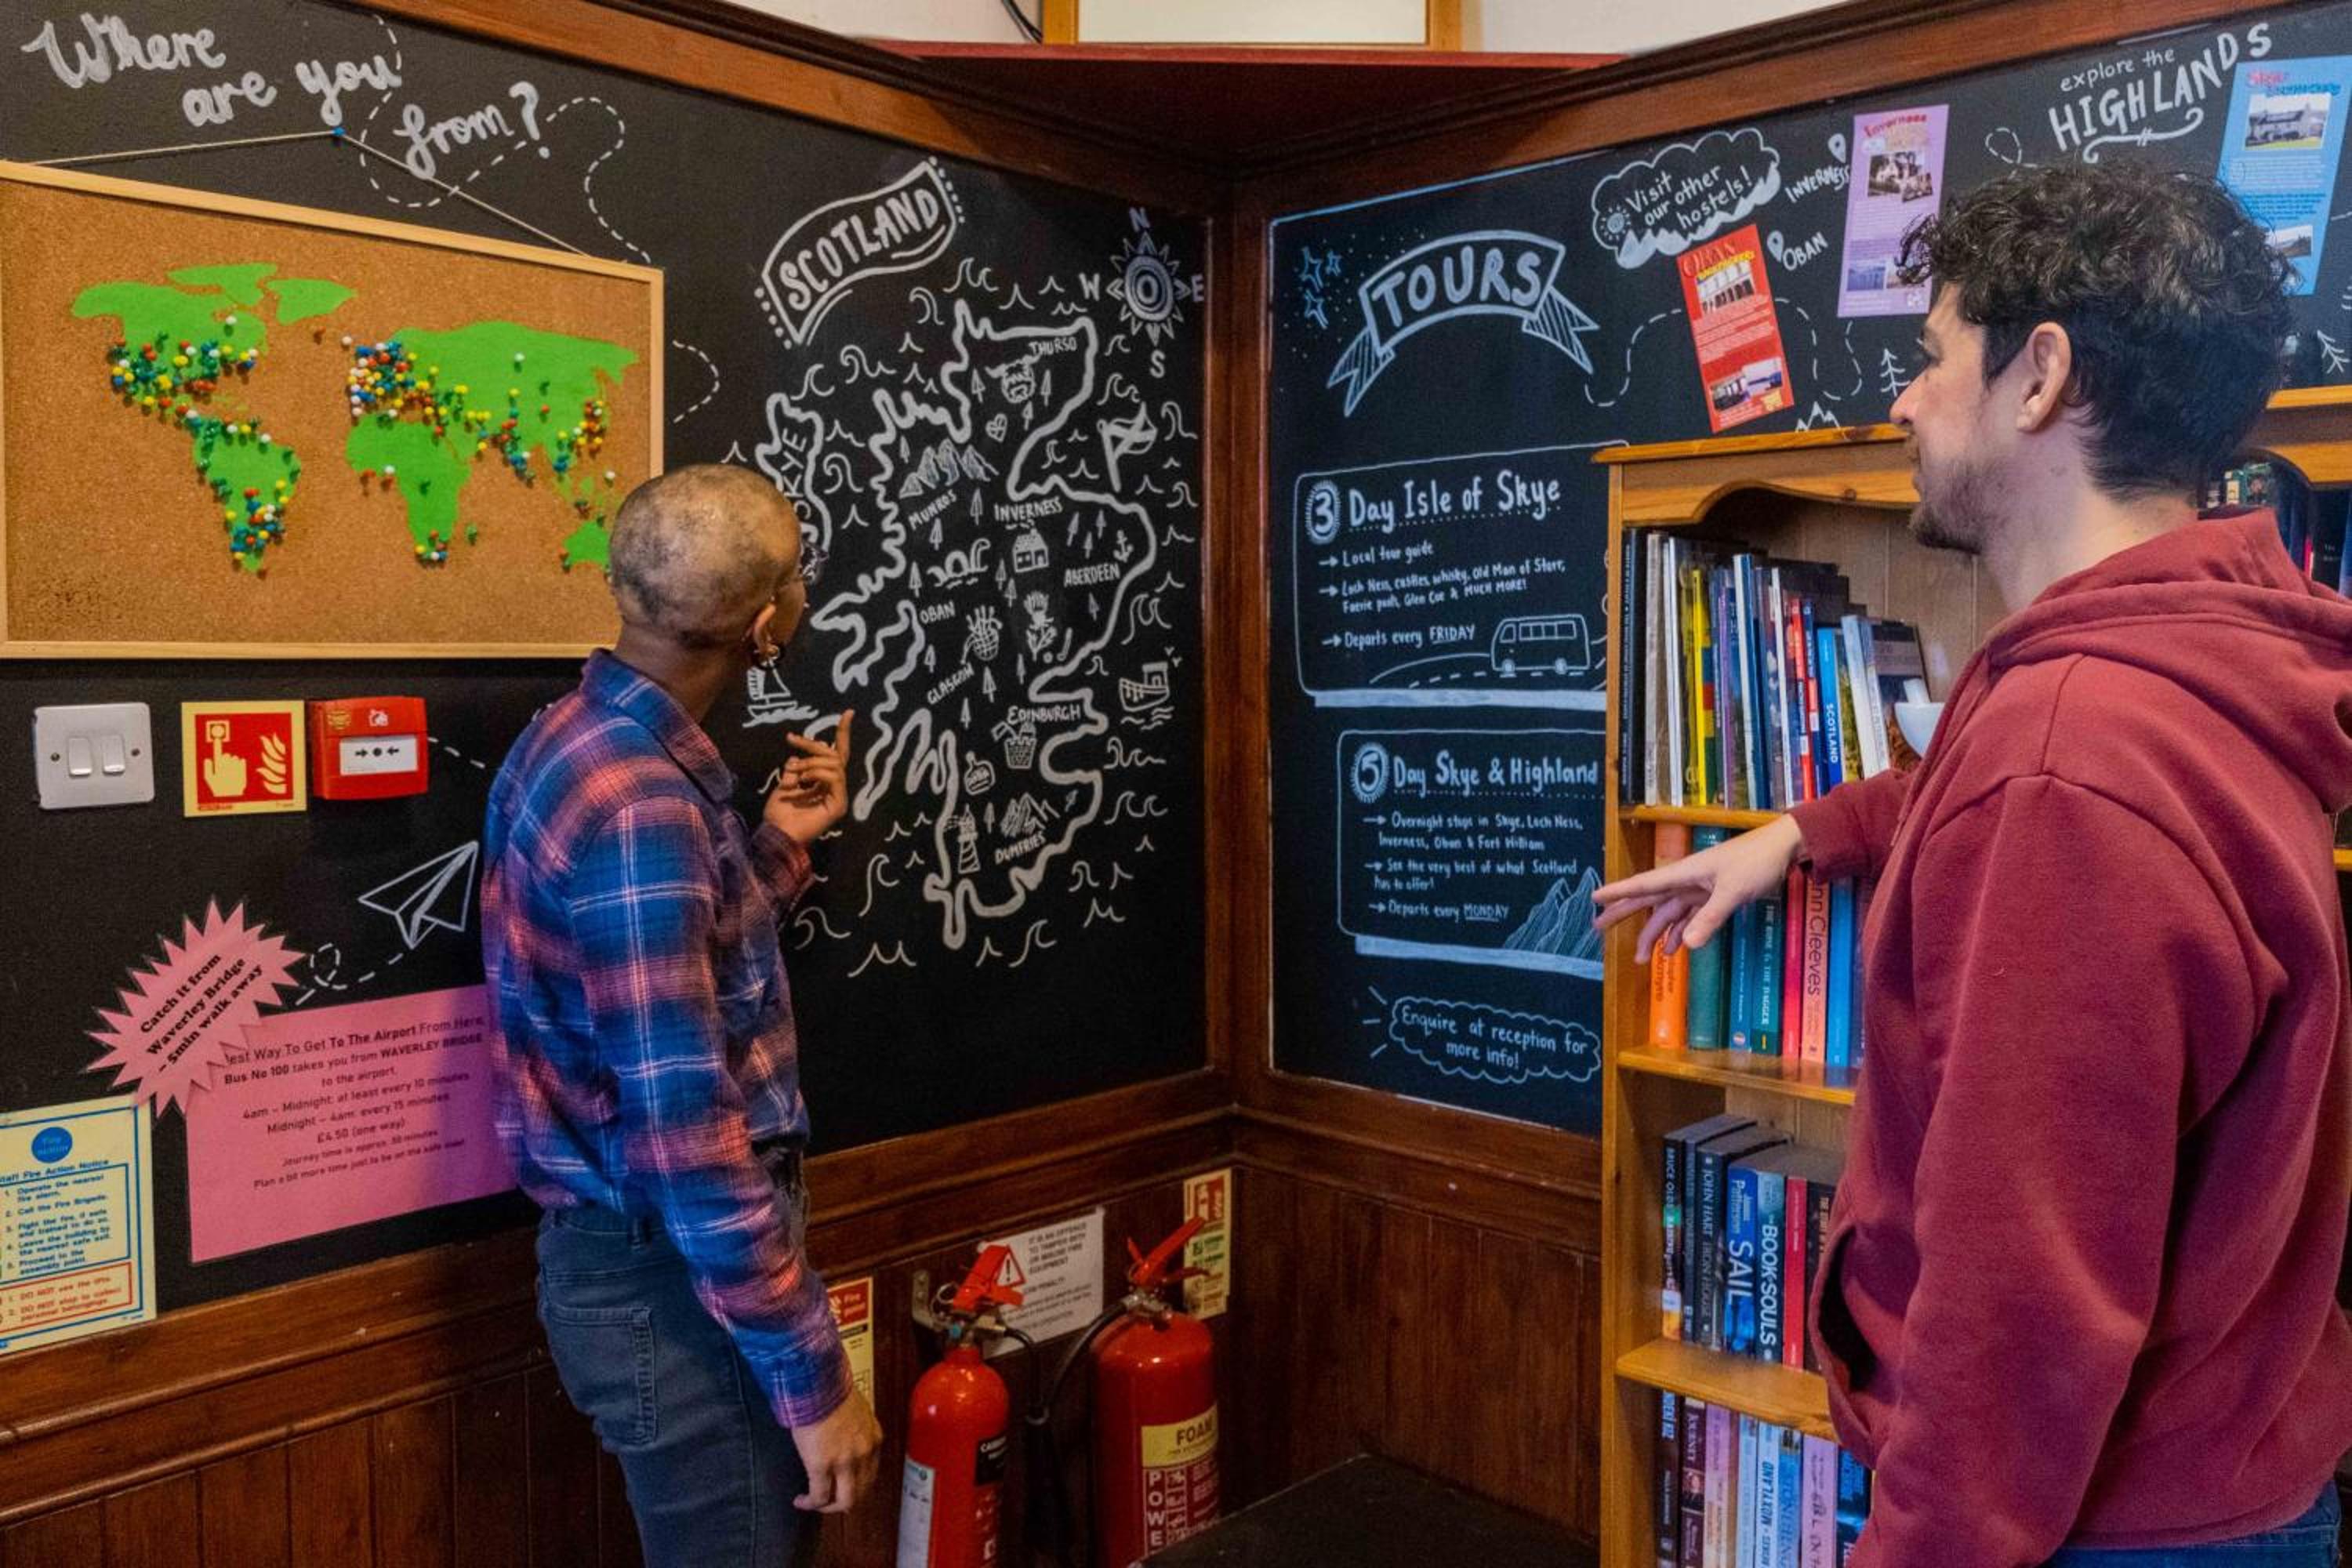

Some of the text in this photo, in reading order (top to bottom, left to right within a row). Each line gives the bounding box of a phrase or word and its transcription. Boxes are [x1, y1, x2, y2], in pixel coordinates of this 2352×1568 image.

[21, 13, 226, 89] Where
[2060, 49, 2175, 92] explore the
[183, 56, 401, 127] are you
[2048, 23, 2272, 152] HIGHLANDS
[1625, 170, 1672, 212] Visit
[1645, 165, 1721, 226] our other
[1677, 165, 1752, 229] hostels!
[1785, 163, 1850, 203] INVERNESS
[1129, 207, 1150, 231] N
[779, 188, 939, 310] SCOTLAND
[1782, 232, 1828, 270] OBAN
[1079, 273, 1100, 301] W
[1192, 274, 1204, 302] E
[1372, 245, 1541, 327] TOURS
[1029, 337, 1077, 354] THURSO
[1149, 350, 1165, 378] S
[909, 489, 956, 530] MUNROS
[994, 496, 1063, 521] INVERNESS
[1314, 470, 1561, 533] 3 Day Isle of Skye
[1342, 539, 1434, 567] Local tour guide
[1064, 563, 1120, 587] ABERDEEN
[1342, 580, 1363, 597] Loch
[1472, 565, 1490, 579] Old
[1492, 562, 1515, 577] Man
[1519, 559, 1530, 575] of
[920, 601, 956, 624] OBAN
[1342, 599, 1373, 614] Faerie
[1403, 592, 1426, 607] Glen
[1428, 590, 1445, 605] Coe
[1465, 581, 1491, 597] MUCH
[1496, 577, 1527, 593] MORE!
[1345, 624, 1475, 650] Departs every FRIDAY
[927, 663, 975, 704] GLASGOW
[1007, 705, 1080, 724] EDINBURGH
[1826, 702, 1838, 764] SCOTLAND
[1360, 750, 1598, 797] 5 Day Skye & Highland
[1379, 832, 1430, 850] Inverness,
[1434, 836, 1463, 849] Oban
[1478, 834, 1500, 850] Fort
[1505, 836, 1545, 851] William
[1392, 811, 1443, 832] Overnight
[1446, 814, 1473, 829] stops
[1478, 814, 1489, 827] in
[1527, 815, 1552, 829] Loch
[995, 831, 1046, 863] DUMFRIES
[1374, 875, 1392, 890] has
[1393, 877, 1404, 890] to
[1387, 858, 1577, 878] See the very best of what Scotland
[1388, 899, 1509, 923] Departs every MONDAY
[1808, 913, 1827, 996] Cleeves
[140, 954, 222, 1033] Catch it from
[146, 958, 246, 1054] Waverley Bridge
[1761, 985, 1770, 1025] DAGGER
[166, 964, 263, 1064] 5min walk away
[1402, 1005, 1588, 1054] Enquire at reception for
[224, 1031, 482, 1086] Bus No 100 takes you from WAVERLEY BRIDGE
[225, 1051, 251, 1067] est
[254, 1047, 281, 1063] Way
[285, 1044, 300, 1056] To
[304, 1040, 327, 1054] Get
[330, 1036, 345, 1049] To
[348, 1033, 370, 1047] The
[374, 1025, 417, 1045] Airport
[419, 1020, 450, 1036] From
[1446, 1041, 1519, 1069] more info!
[242, 1106, 268, 1120] 4am
[337, 1092, 349, 1103] at
[351, 1087, 379, 1101] least
[381, 1081, 412, 1096] every
[427, 1072, 470, 1086] minutes
[321, 1075, 333, 1087] to
[336, 1071, 354, 1084] the
[267, 1116, 316, 1135] Midnight
[361, 1104, 390, 1119] every
[407, 1093, 451, 1107] minutes
[1701, 1169, 1715, 1203] JOHN
[1700, 1204, 1715, 1238] HART
[1728, 1240, 1755, 1305] SAIL
[1759, 1224, 1779, 1347] BOOK SOULS
[1177, 1420, 1214, 1446] FOAM
